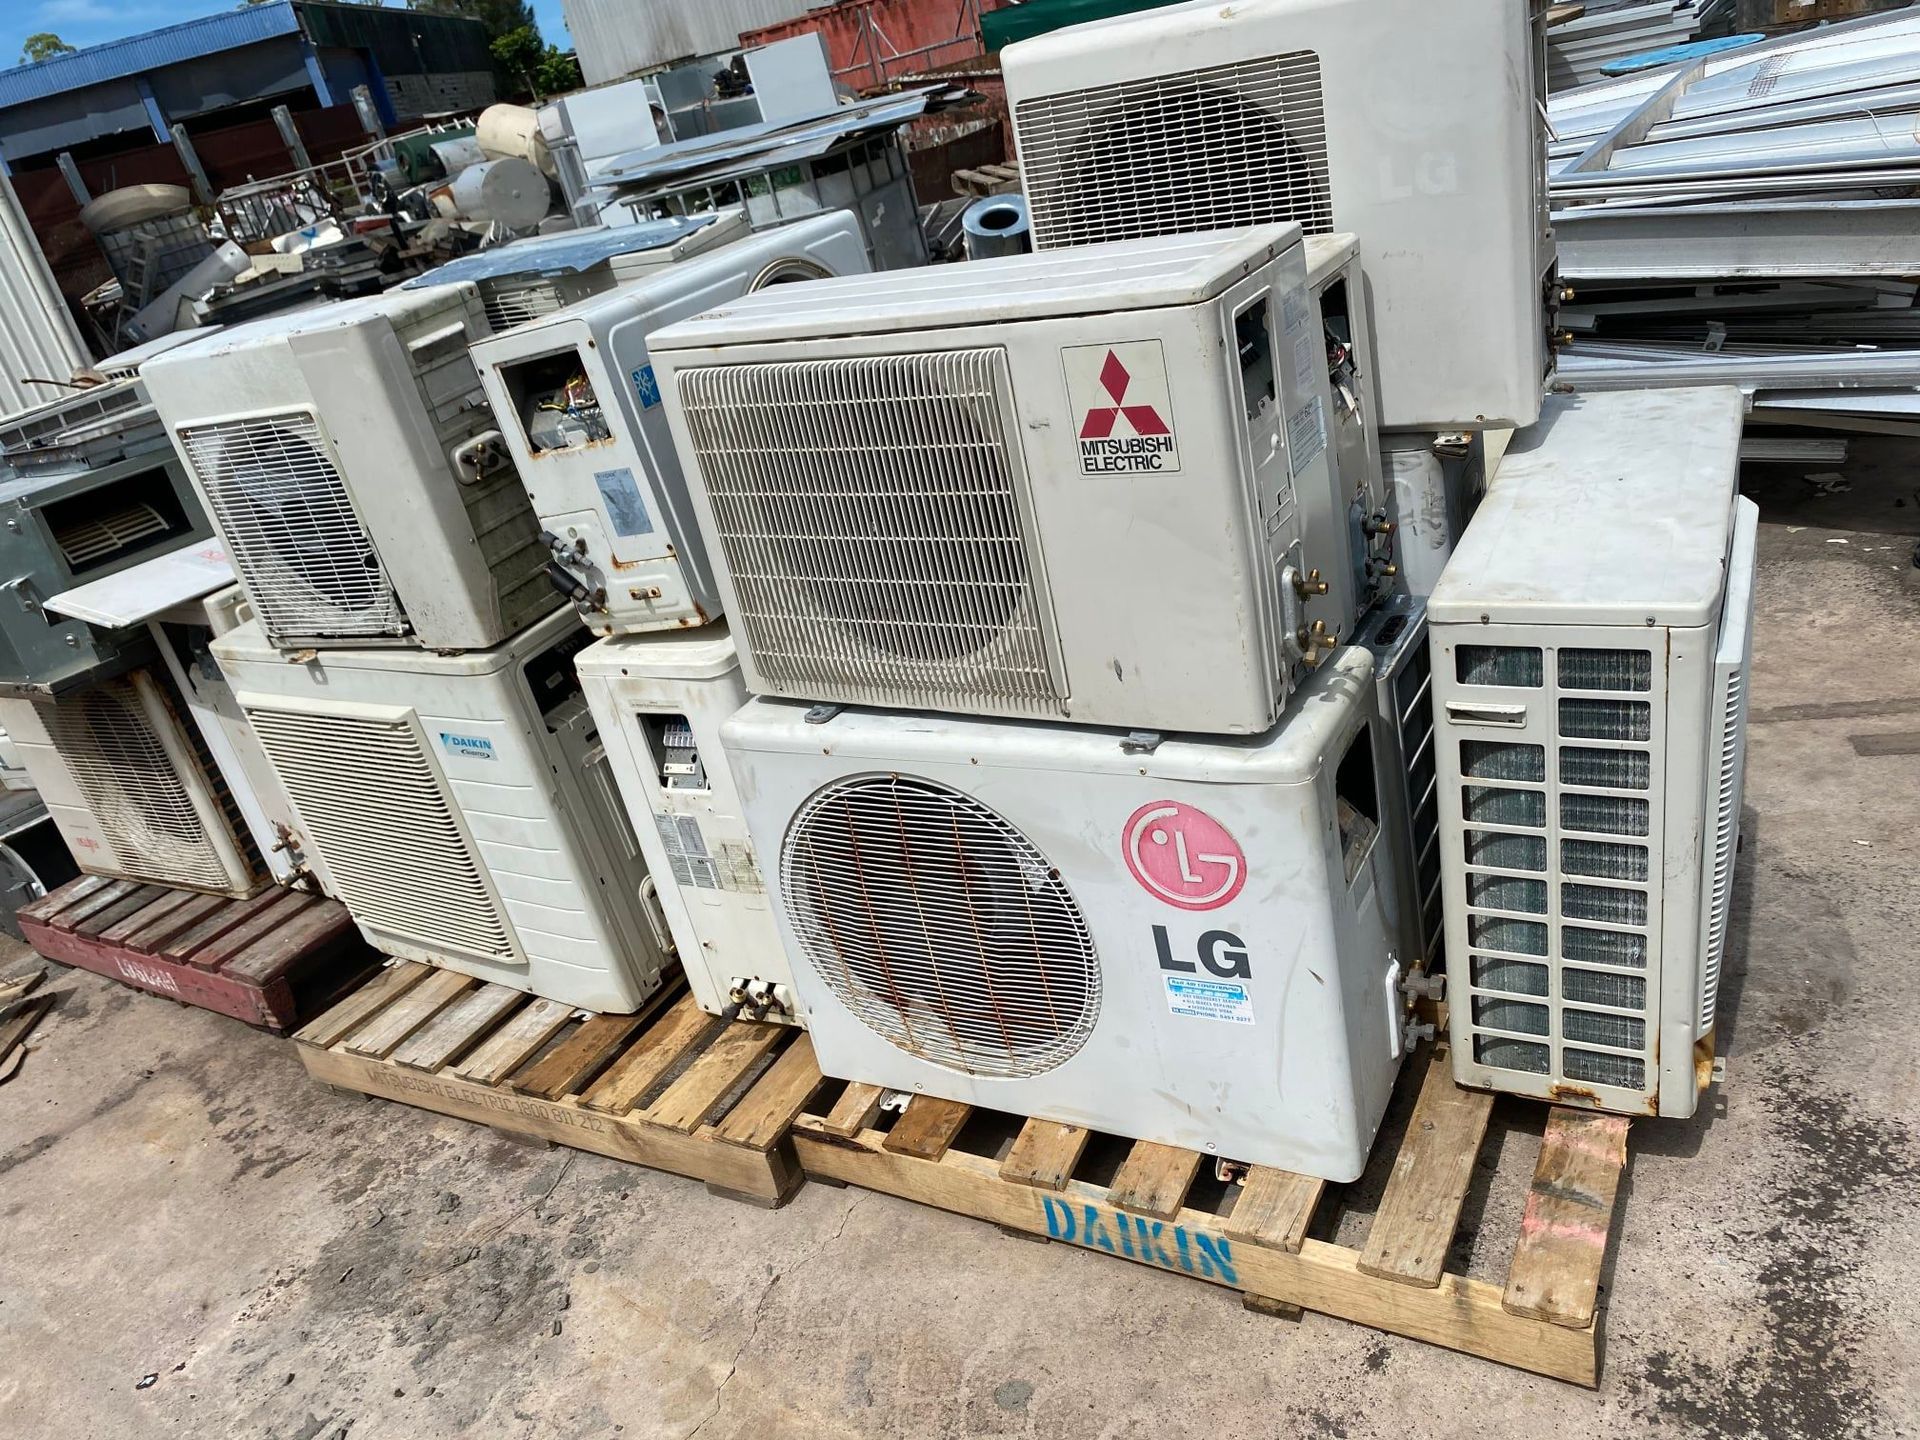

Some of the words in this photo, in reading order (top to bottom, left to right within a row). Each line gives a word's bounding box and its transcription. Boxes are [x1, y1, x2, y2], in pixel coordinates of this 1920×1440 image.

[1080, 436, 1173, 455] MITSUBISHI
[1083, 454, 1162, 472] ELECTRIC
[451, 737, 491, 750] DAIKIN
[1151, 924, 1252, 978] LG
[366, 1067, 444, 1096] MITSUBISHI
[444, 1085, 514, 1112] ELECTRIC
[516, 1101, 550, 1120] 1800
[552, 1108, 576, 1126] 811
[577, 1114, 606, 1134] 212
[1042, 1195, 1238, 1284] DAIKIN
